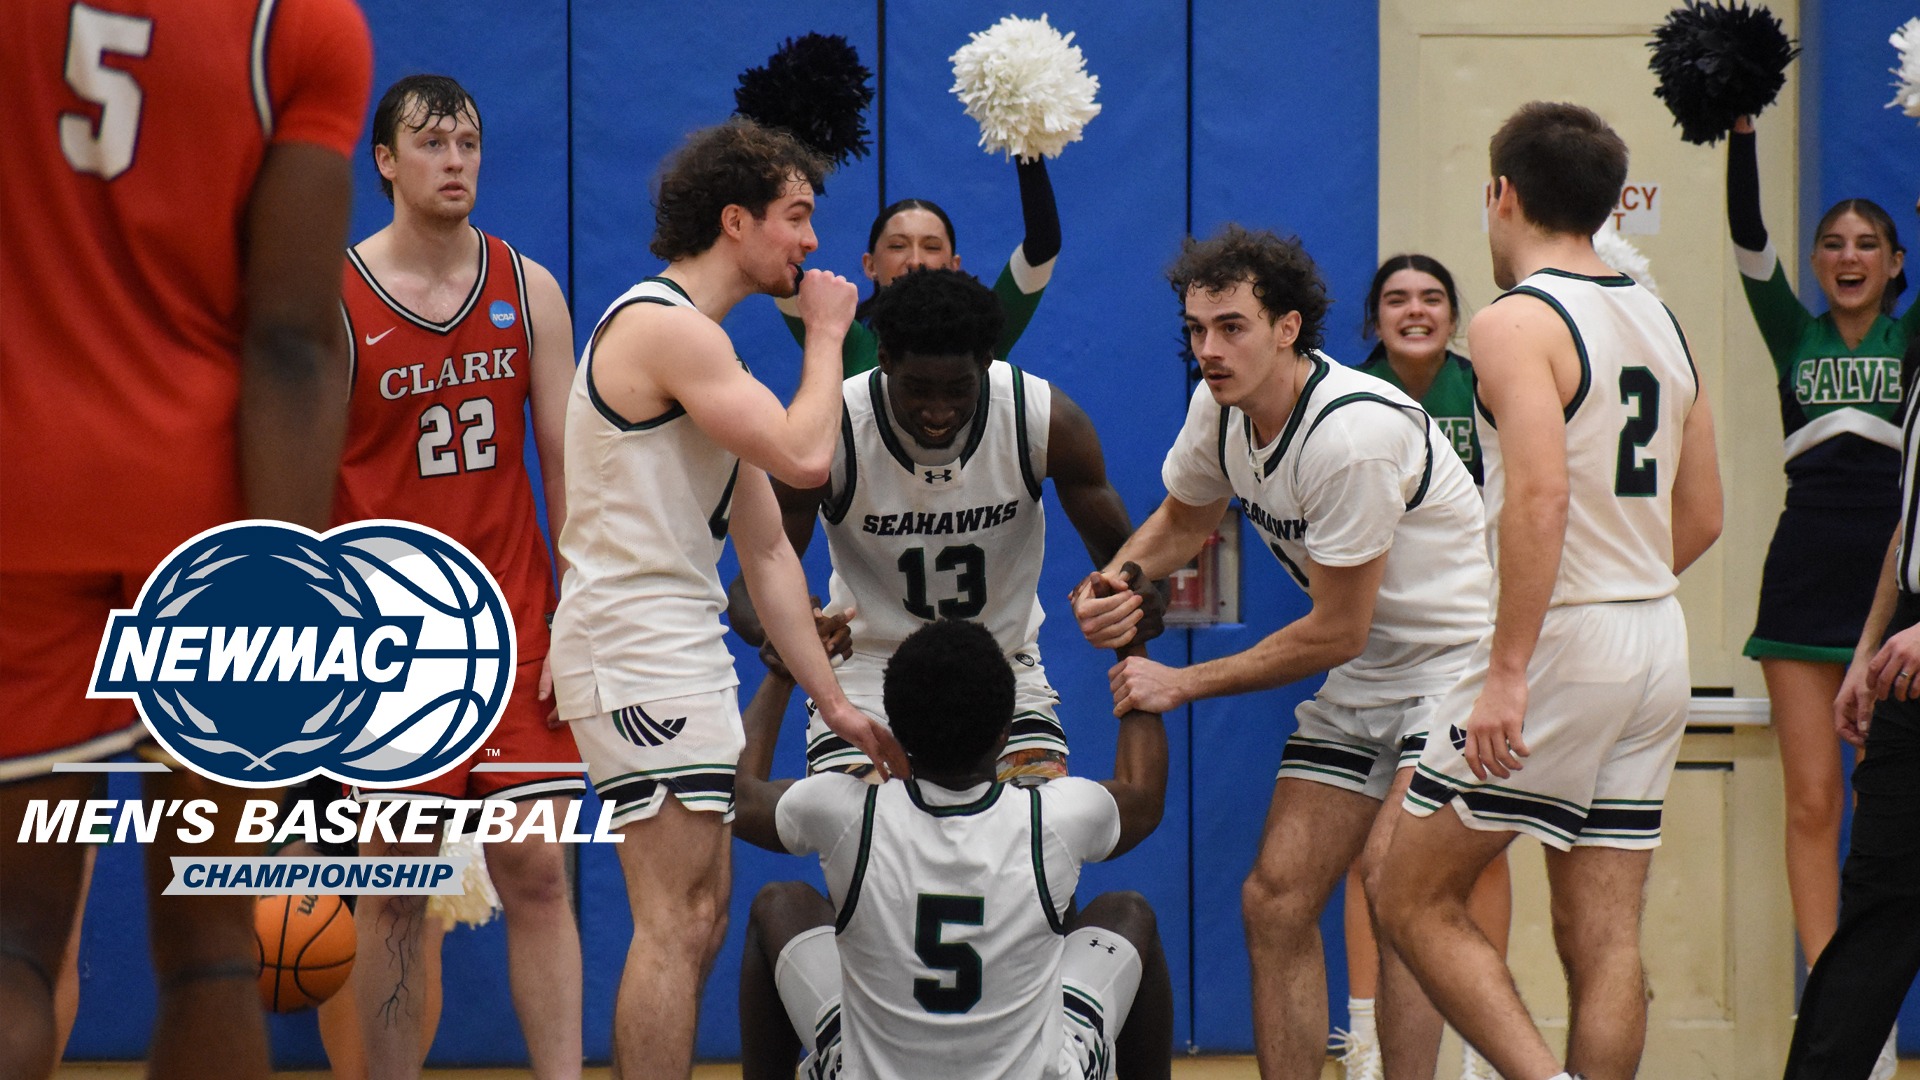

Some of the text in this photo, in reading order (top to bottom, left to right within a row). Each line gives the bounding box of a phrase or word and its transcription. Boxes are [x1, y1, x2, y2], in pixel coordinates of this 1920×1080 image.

[59, 2, 154, 181] 5
[492, 313, 515, 321] NCAA
[379, 347, 517, 401] CLARK
[1796, 357, 1902, 404] SALVE
[417, 397, 497, 478] 22
[1615, 366, 1660, 497] 2
[862, 500, 1018, 536] SEAHAWKS
[897, 544, 987, 620] 13
[913, 894, 984, 1014] 5
